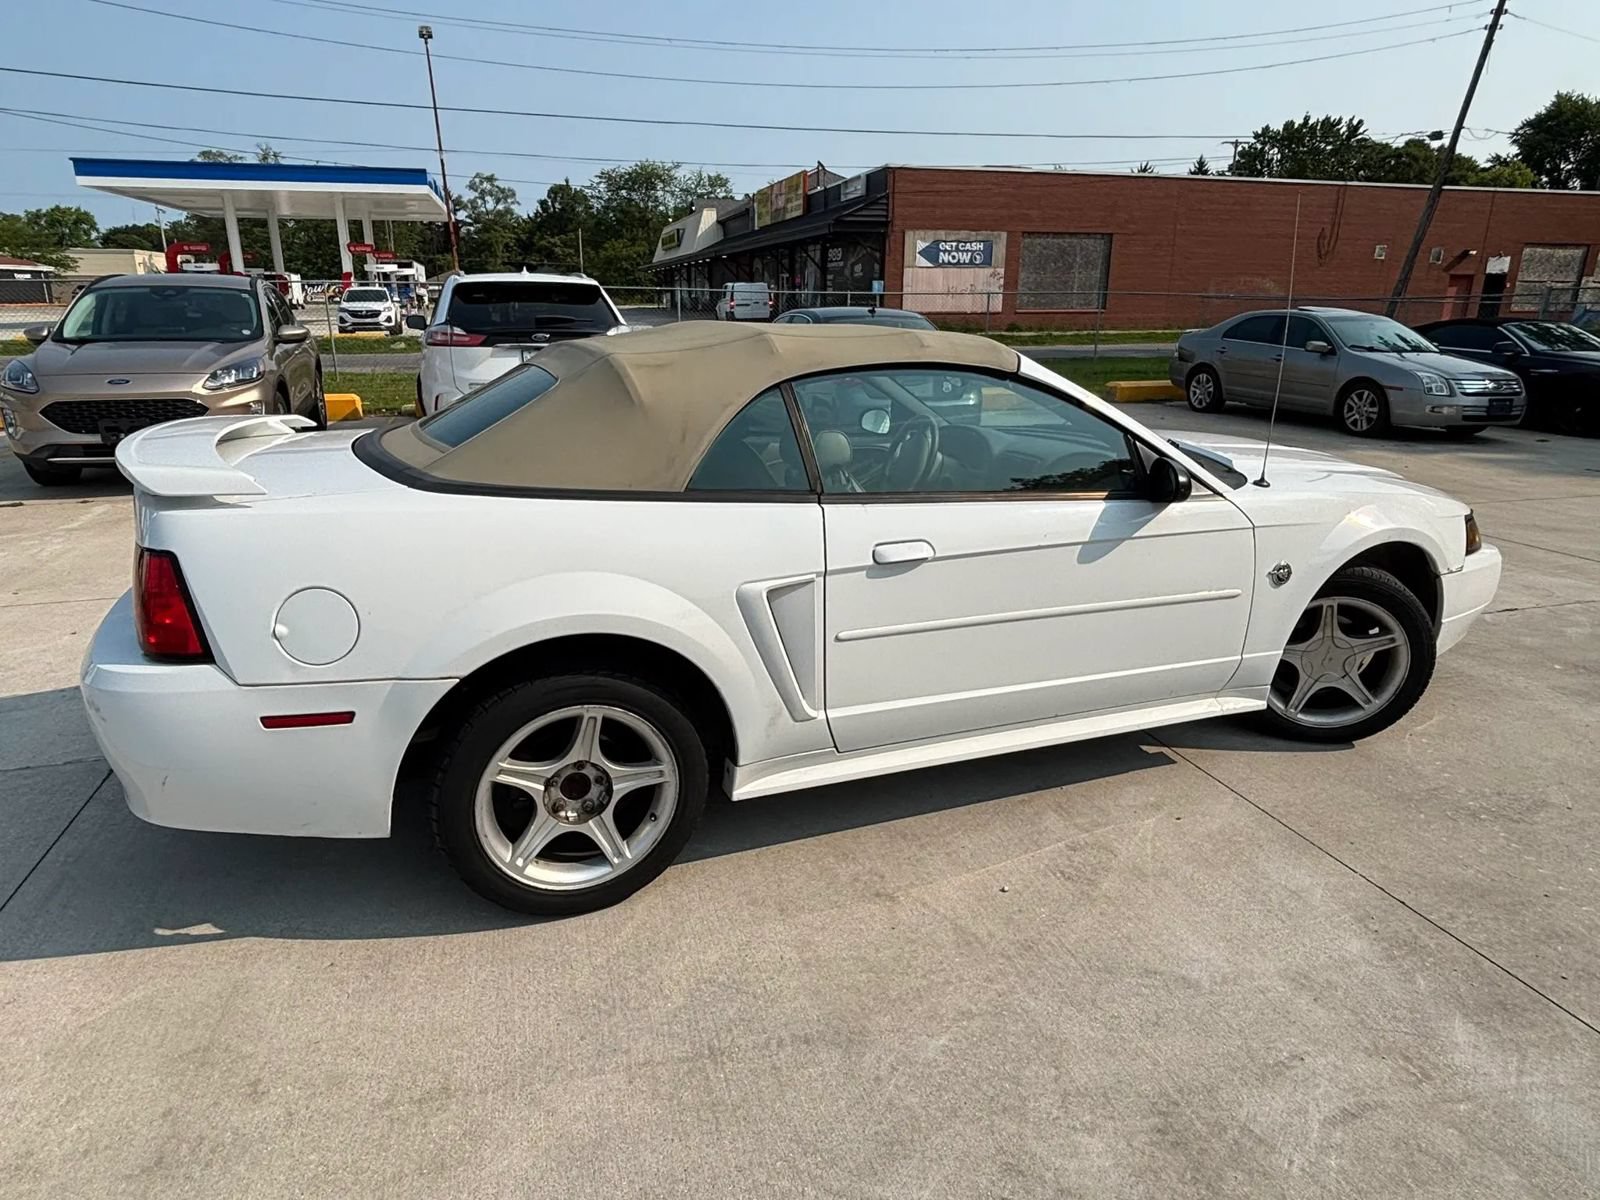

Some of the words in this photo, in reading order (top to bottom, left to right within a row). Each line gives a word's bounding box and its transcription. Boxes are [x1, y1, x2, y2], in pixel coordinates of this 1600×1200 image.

[939, 242, 957, 251] GET
[958, 242, 984, 251] CASH
[938, 251, 972, 264] NOW
